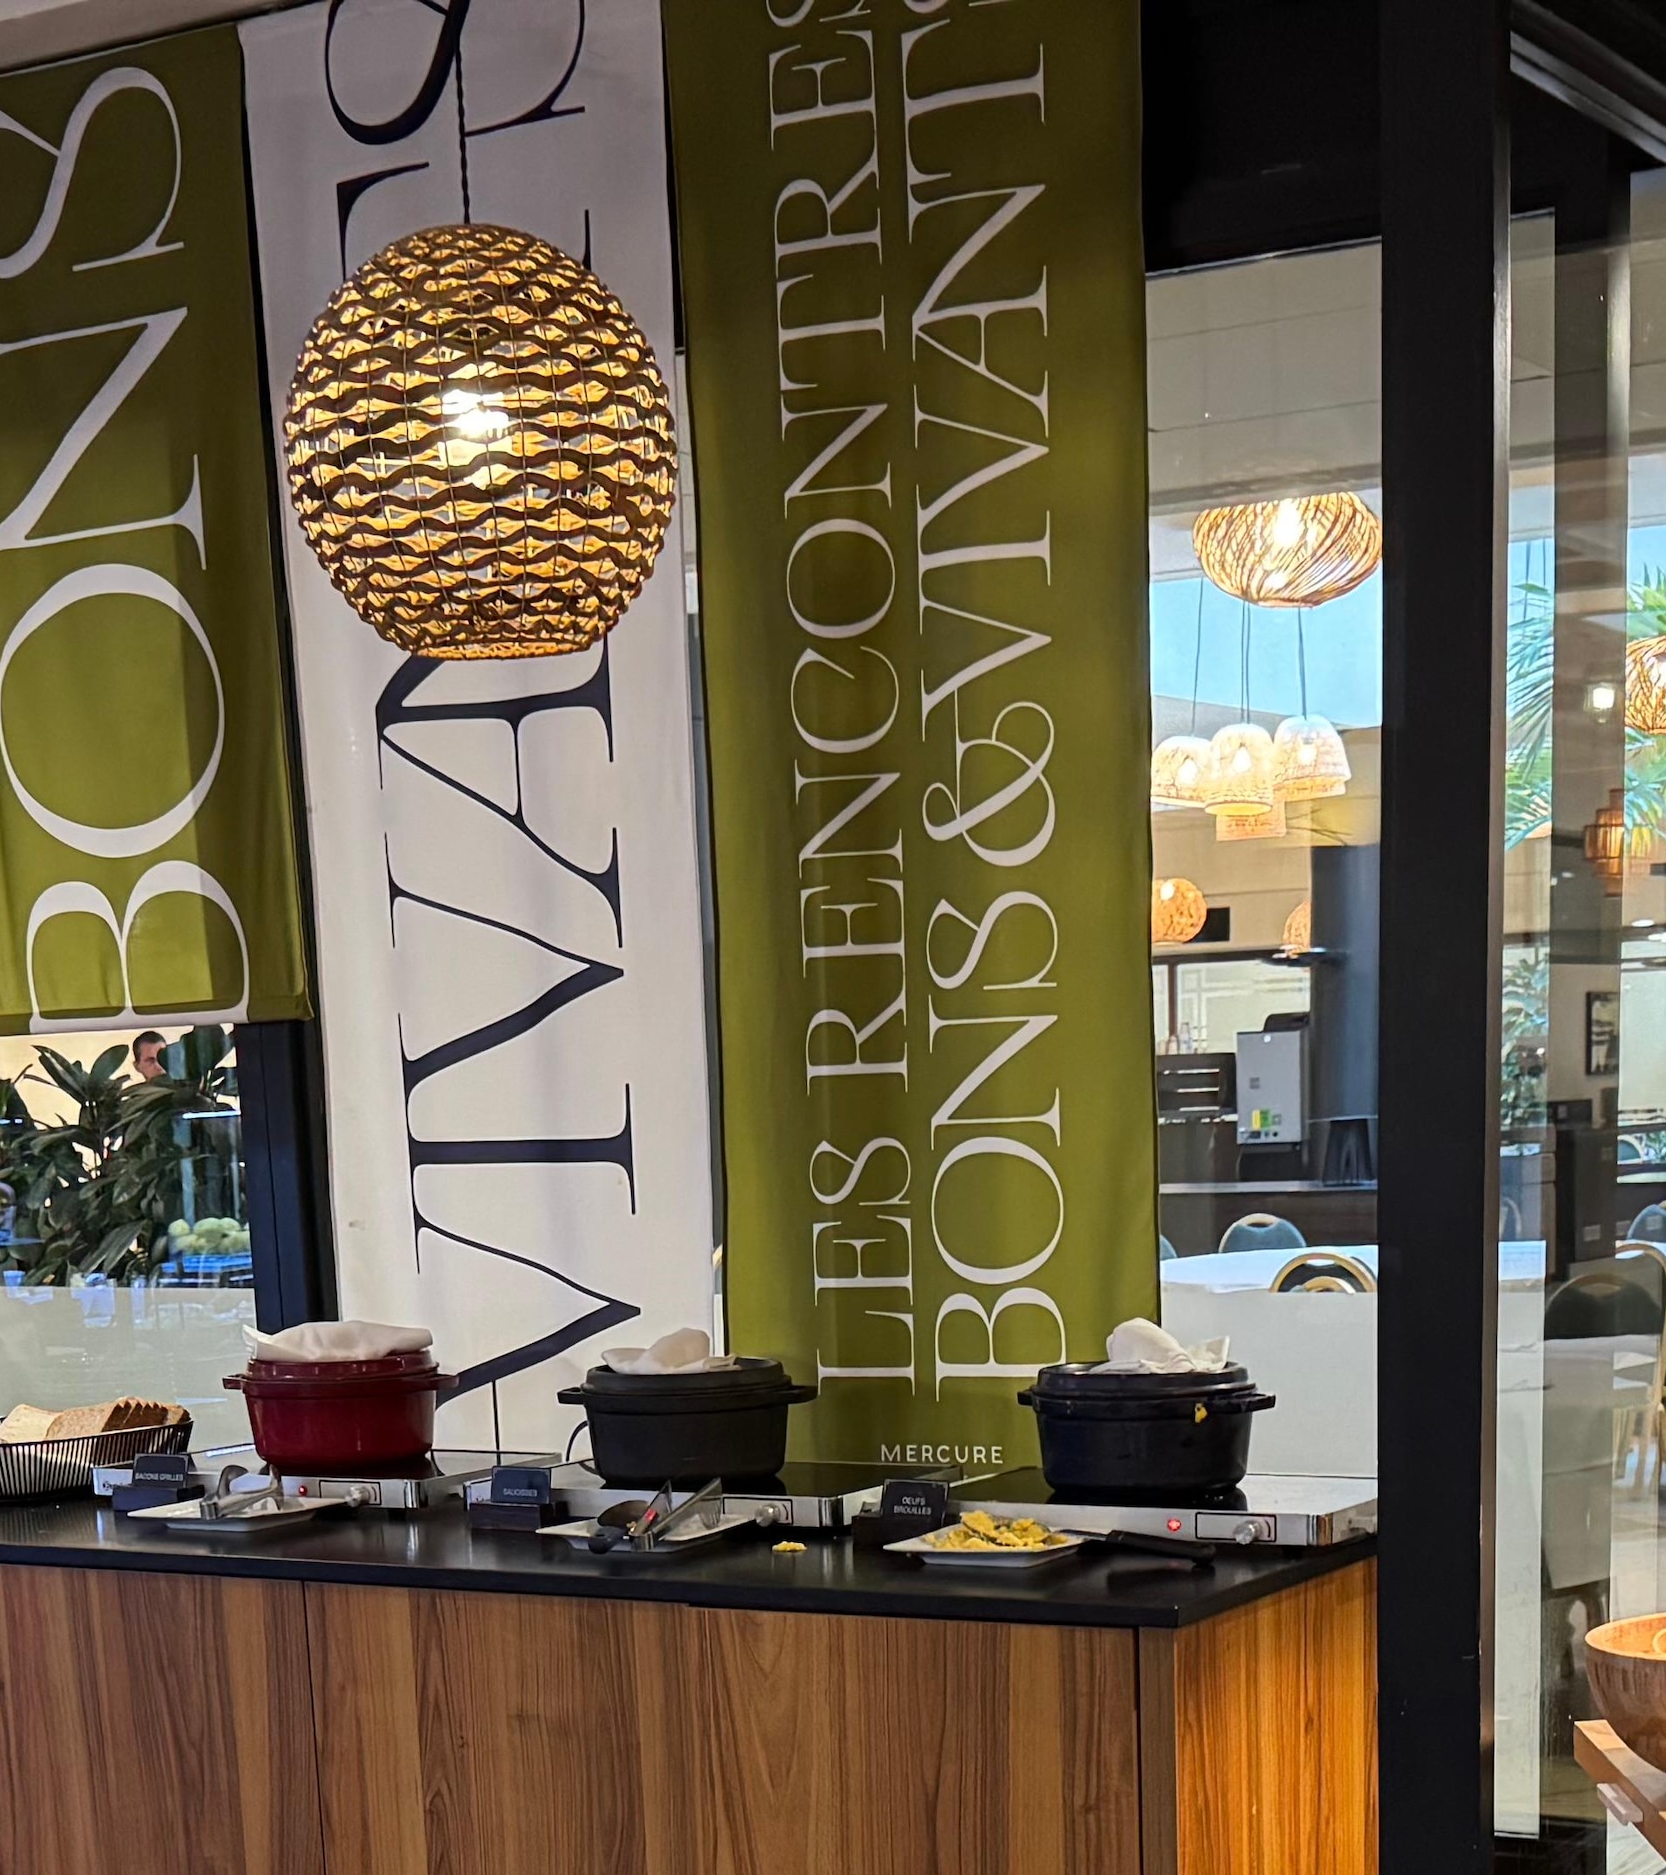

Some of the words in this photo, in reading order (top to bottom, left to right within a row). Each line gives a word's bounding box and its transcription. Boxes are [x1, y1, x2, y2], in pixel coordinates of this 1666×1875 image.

[899, 0, 1067, 1402] BONS&VIVANT
[809, 1136, 915, 1396] LES
[880, 1443, 1004, 1465] MERCURE
